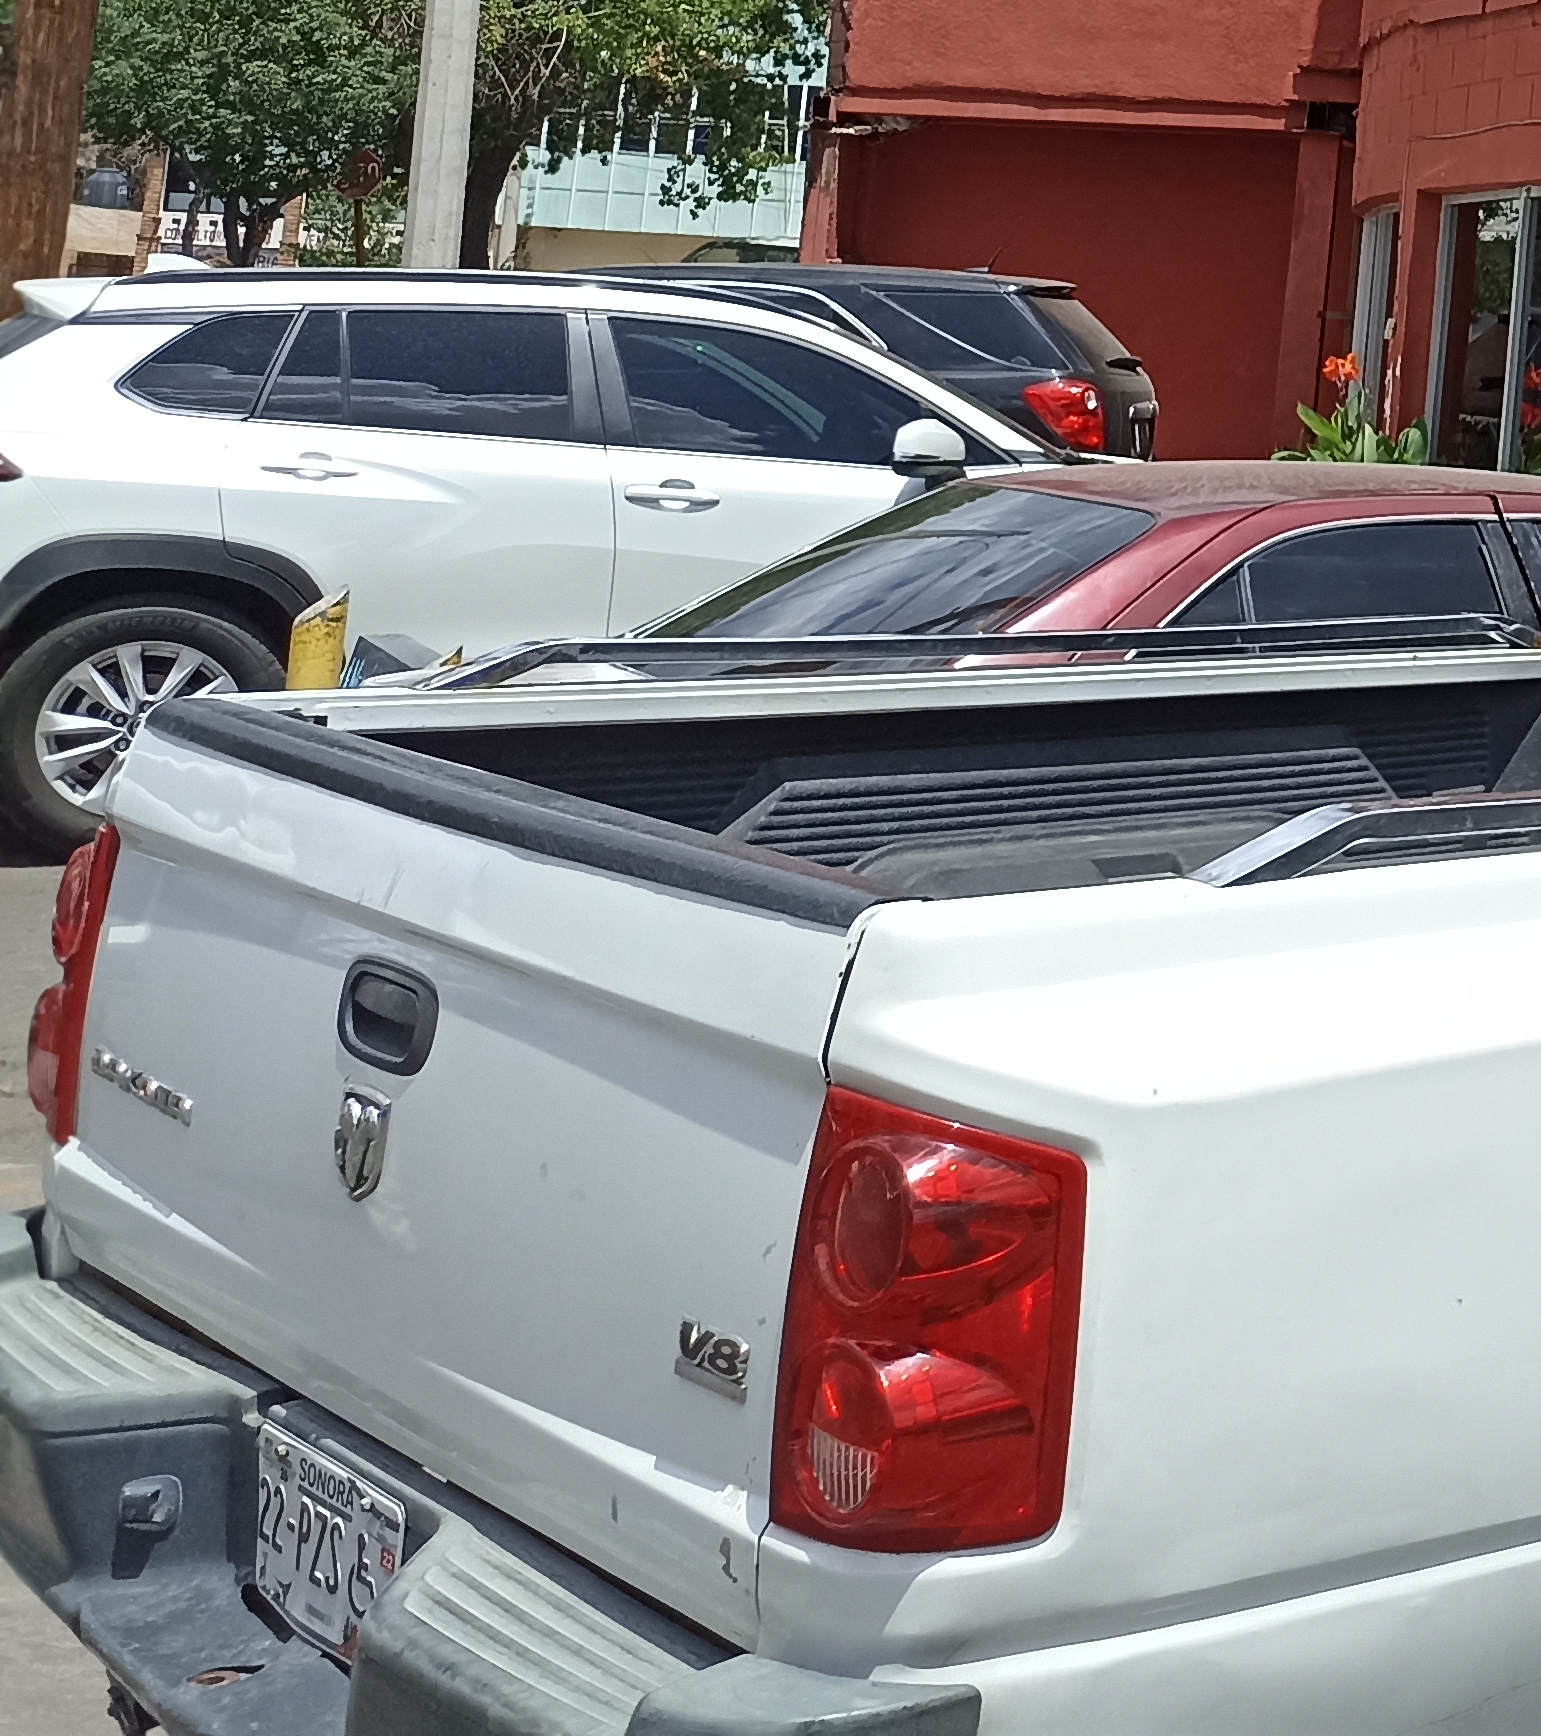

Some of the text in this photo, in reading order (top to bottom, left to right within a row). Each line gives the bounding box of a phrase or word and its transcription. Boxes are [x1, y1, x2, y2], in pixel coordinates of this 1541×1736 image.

[678, 1315, 749, 1381] V8
[299, 1457, 354, 1512] SONORA
[259, 1474, 346, 1595] 22-PZS
